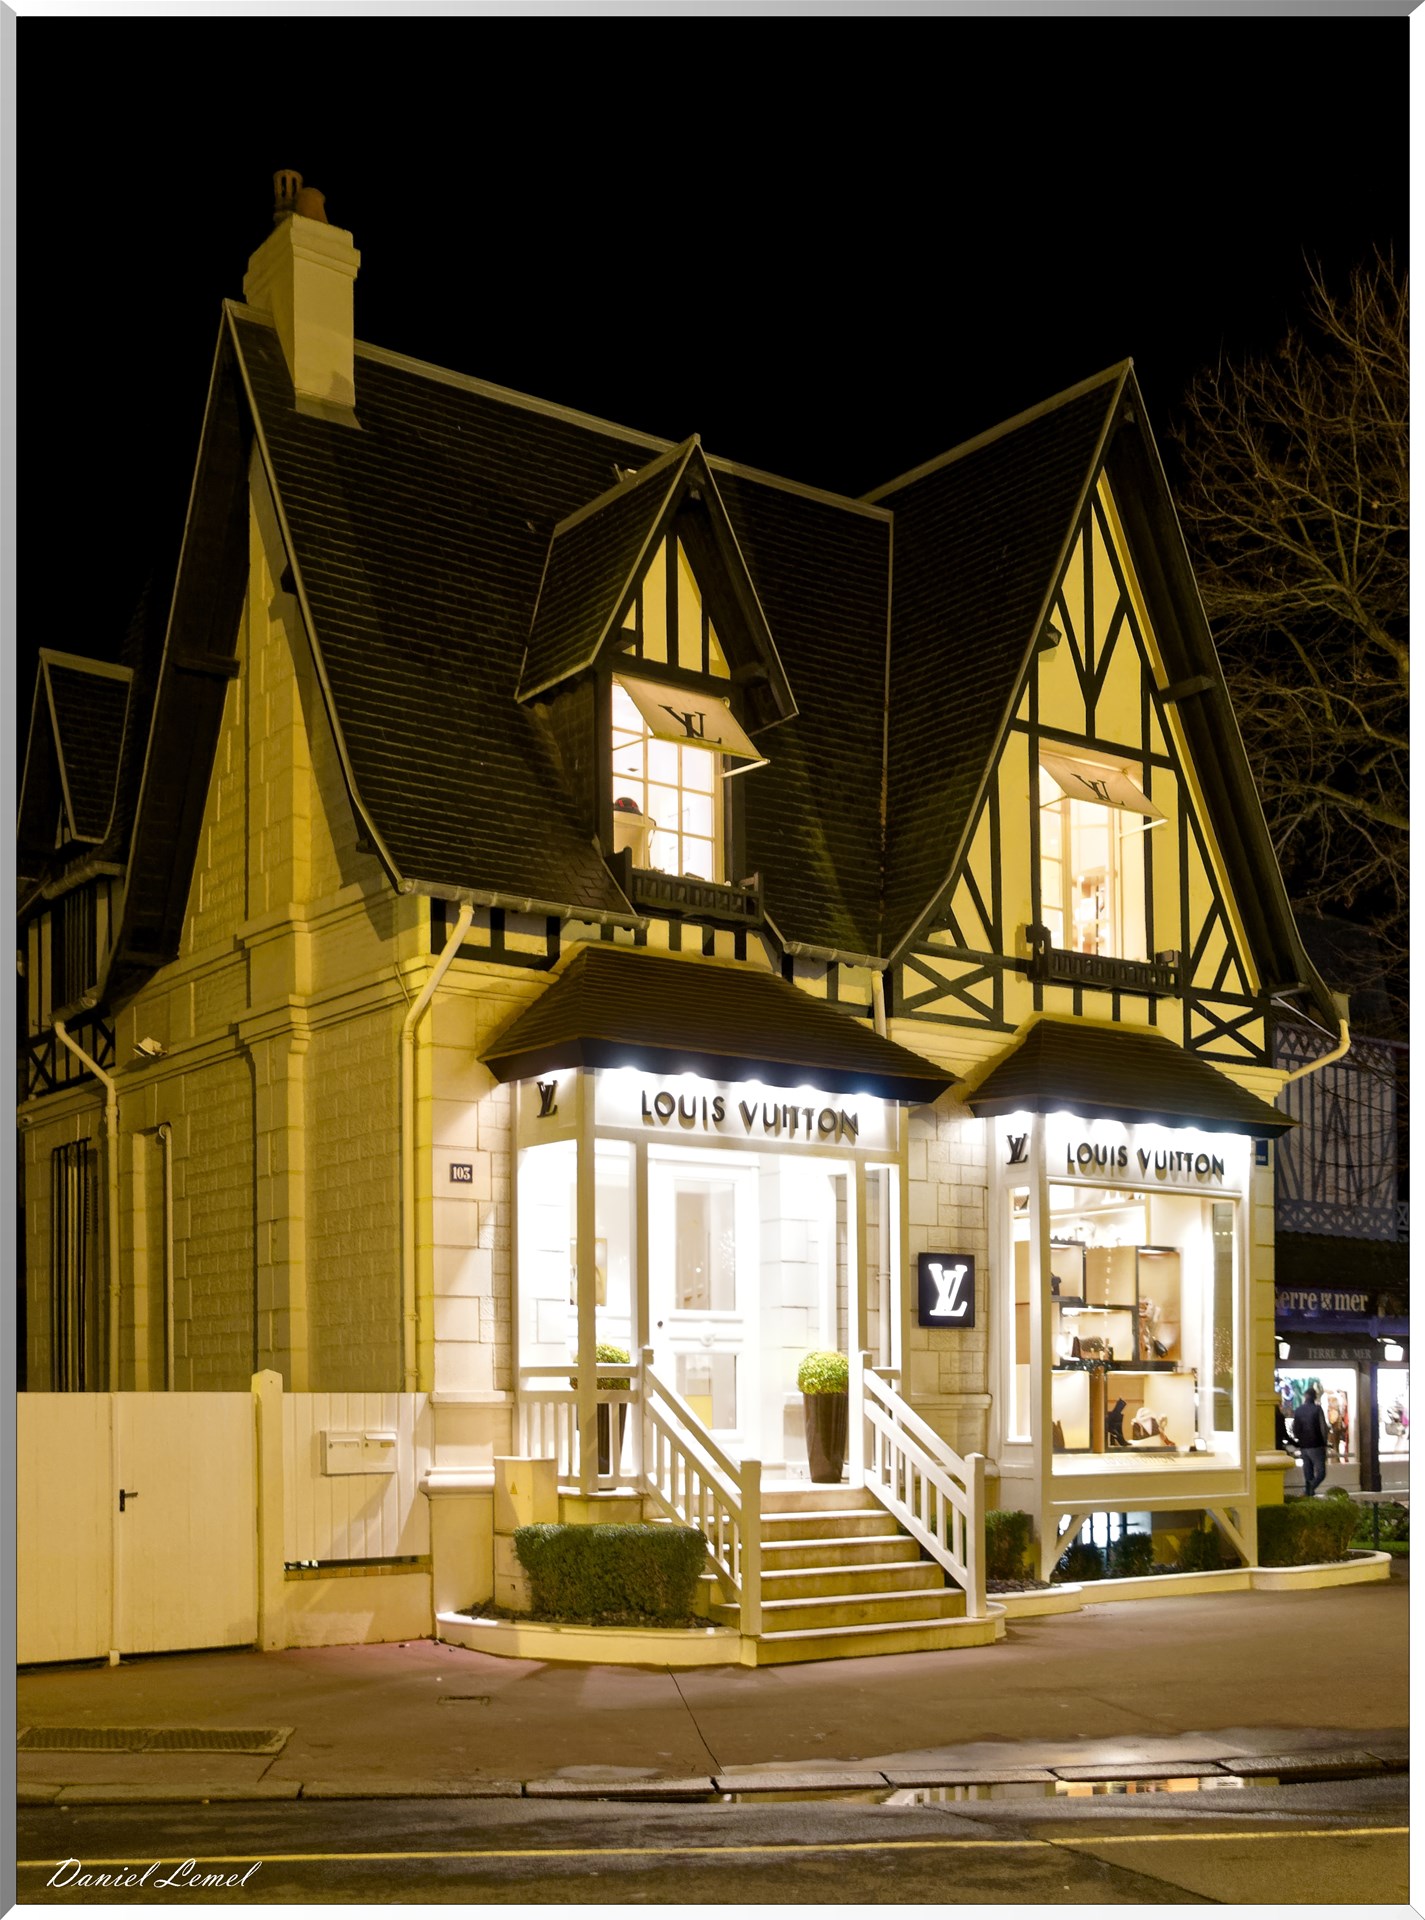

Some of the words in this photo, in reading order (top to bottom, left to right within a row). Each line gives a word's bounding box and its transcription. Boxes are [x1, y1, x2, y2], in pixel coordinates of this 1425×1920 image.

[641, 1090, 725, 1122] LOUIS
[739, 1100, 859, 1136] VUITTON
[452, 1166, 471, 1180] 103
[1067, 1142, 1128, 1168] LOUIS
[1137, 1148, 1225, 1175] VUITTON
[1275, 1287, 1318, 1311] erre
[1334, 1293, 1369, 1312] mer
